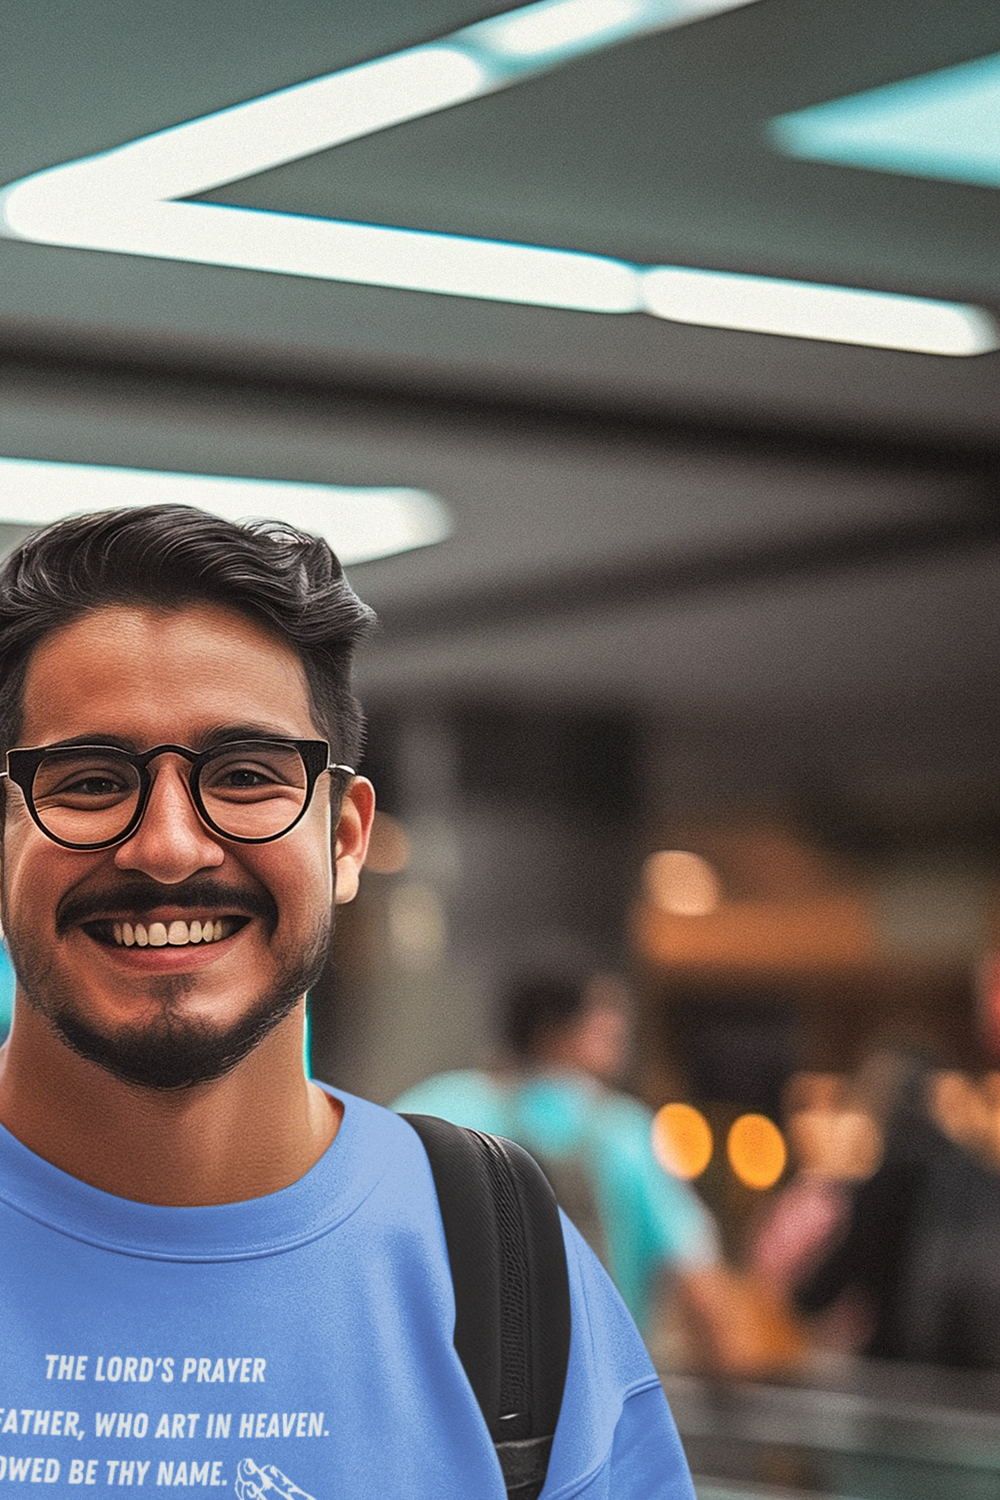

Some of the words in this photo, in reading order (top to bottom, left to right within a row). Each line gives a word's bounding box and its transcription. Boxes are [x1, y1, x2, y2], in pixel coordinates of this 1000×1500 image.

[45, 1354, 89, 1381] THE
[181, 1357, 267, 1383] PRAYER
[95, 1412, 149, 1439] WHO
[154, 1413, 200, 1439] ART
[205, 1413, 232, 1439] IN
[238, 1412, 330, 1438] HEAVEN.
[68, 1459, 99, 1485] BE
[106, 1460, 151, 1486] THY
[156, 1461, 228, 1486] NAME.
